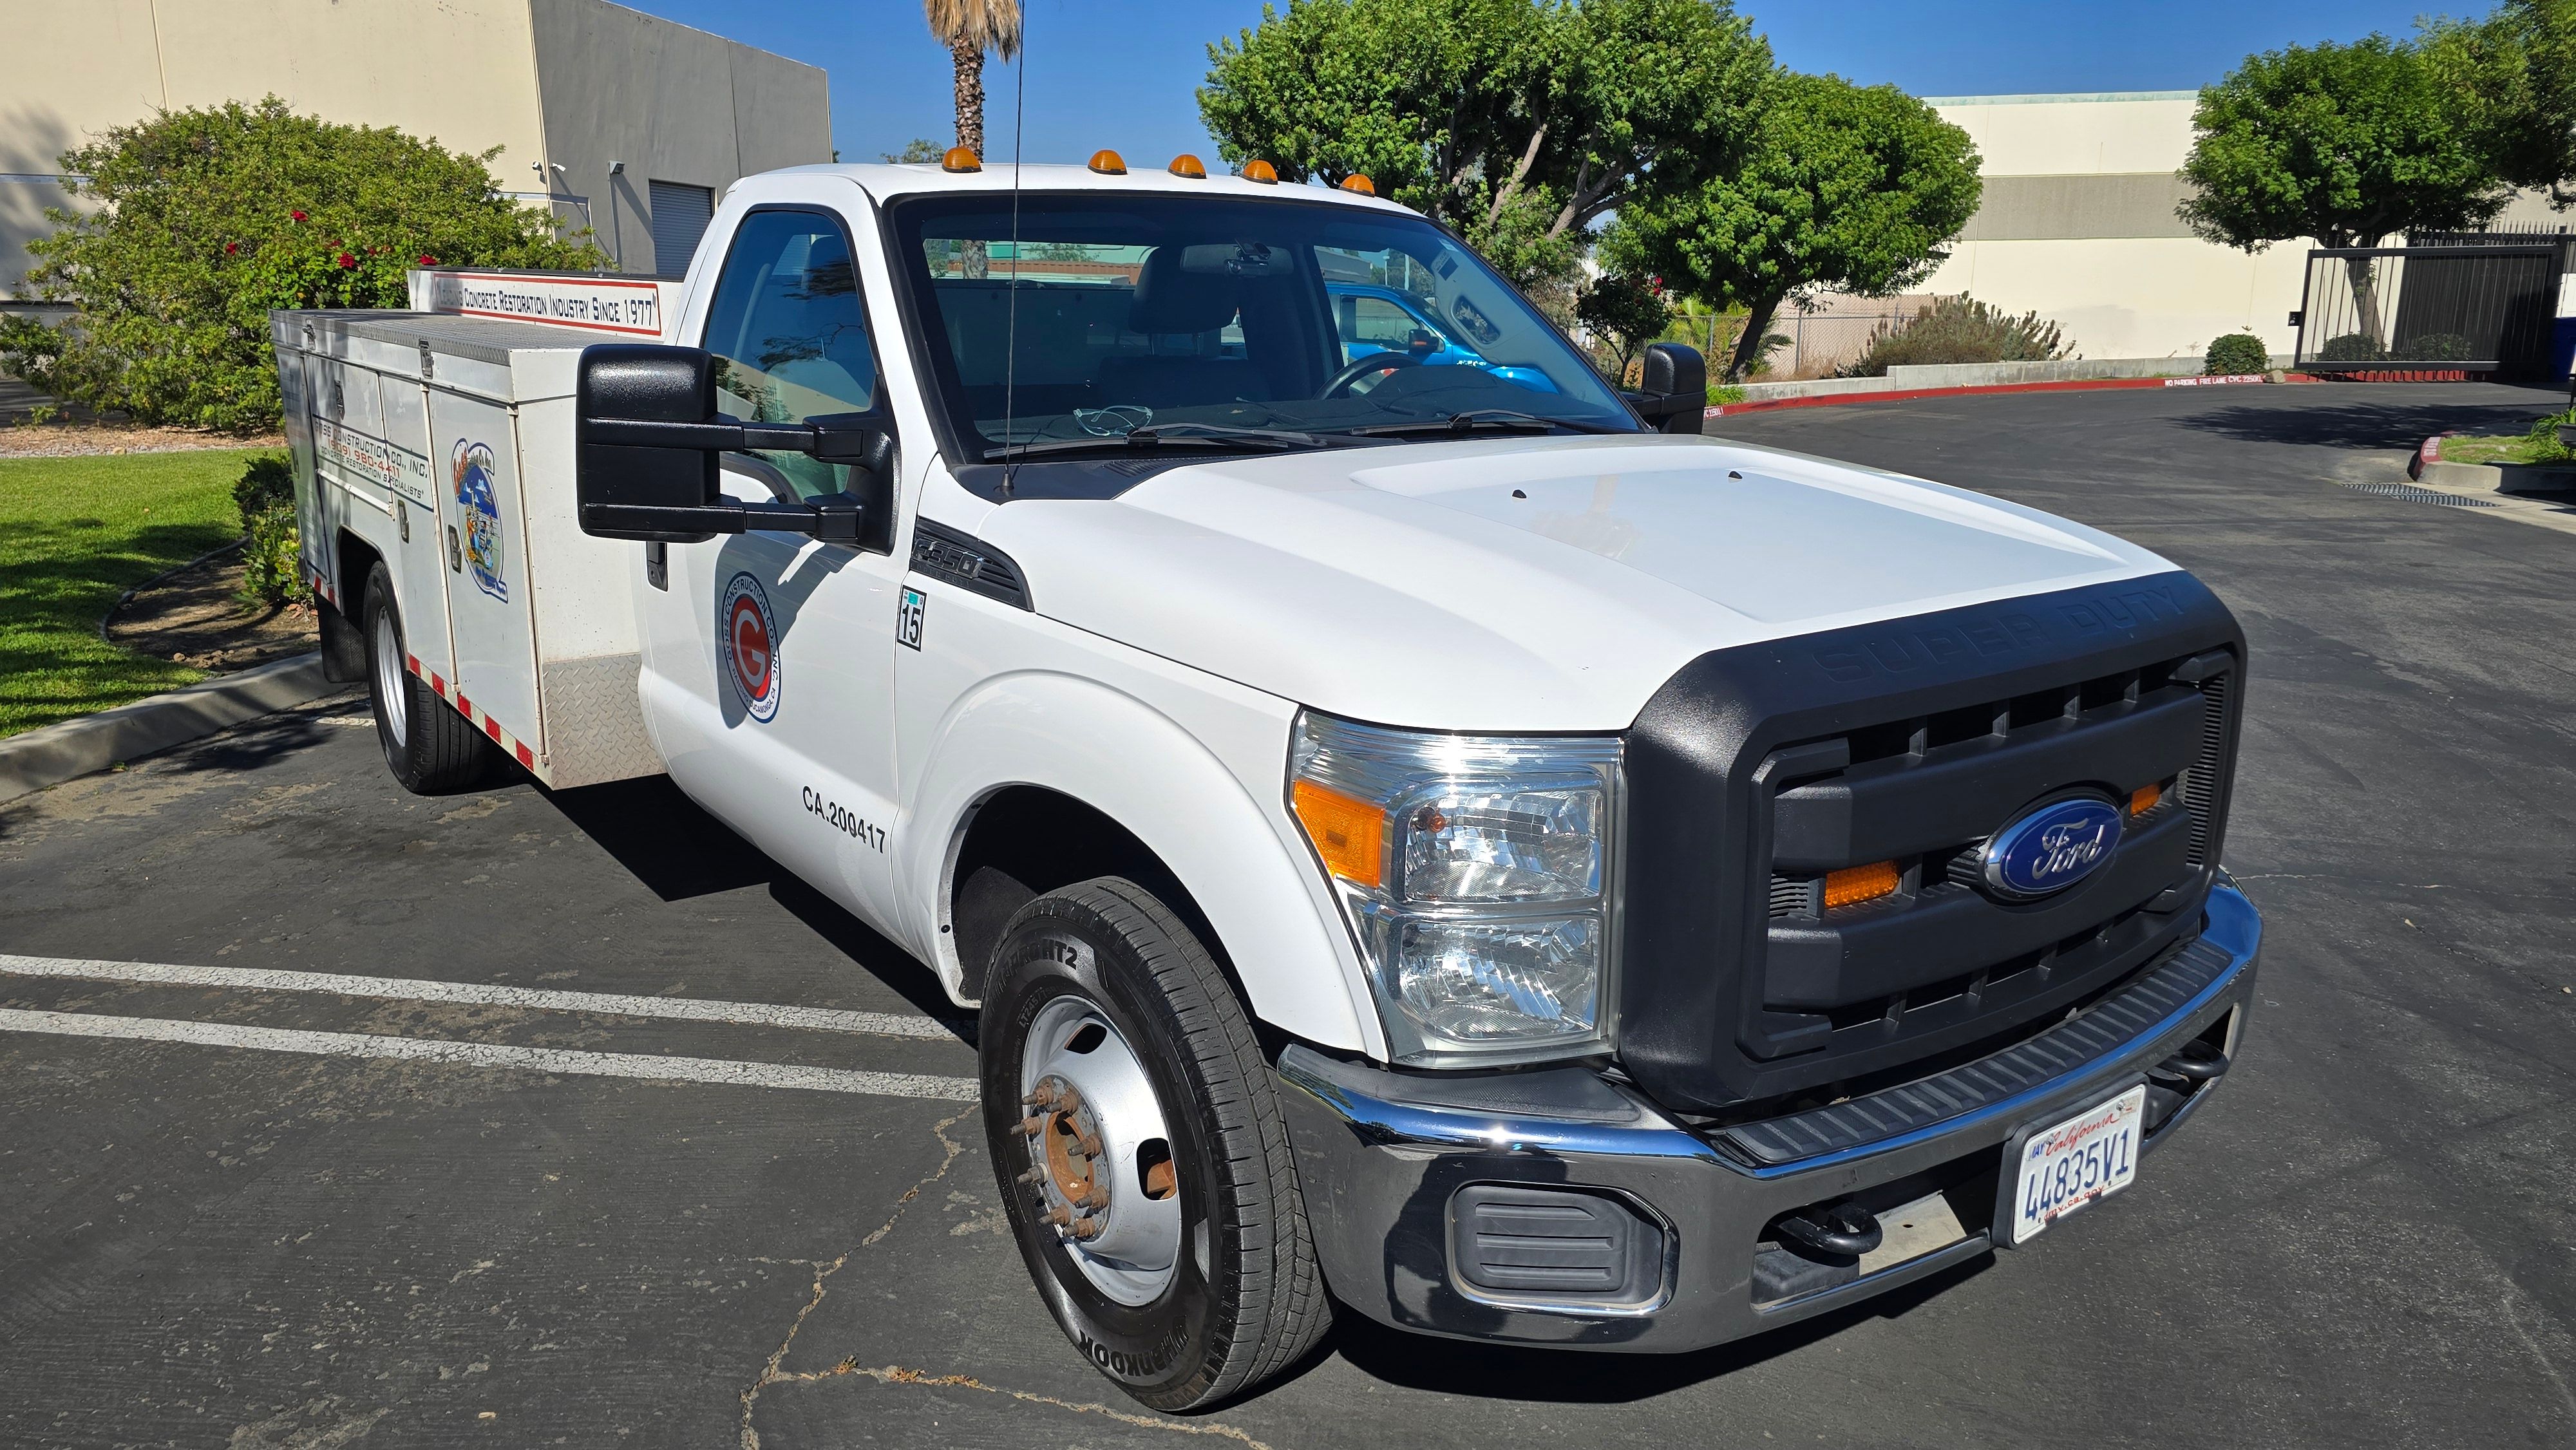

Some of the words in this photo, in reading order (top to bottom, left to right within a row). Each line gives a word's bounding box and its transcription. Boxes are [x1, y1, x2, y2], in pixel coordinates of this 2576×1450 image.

[464, 288, 498, 310] CONCRETE
[498, 290, 547, 315] RESTORATION
[549, 294, 589, 319] INDUSTRY
[592, 297, 620, 322] SINCE
[328, 438, 351, 457] (909)
[333, 428, 390, 460] CONSTRUCTION
[410, 458, 428, 478] INC.
[346, 457, 381, 480] RESTORATION
[725, 579, 768, 616] CONSTRUCTION
[724, 617, 732, 661] GOSS
[902, 603, 921, 644] 15
[1812, 613, 2054, 684] SUPER
[2056, 586, 2186, 634] DUTY
[735, 608, 765, 687] G
[732, 668, 749, 702] RANCHO
[770, 687, 776, 699] CA
[802, 786, 886, 854] CA.200417
[2032, 817, 2105, 880] Ford
[1042, 938, 1078, 971] HT2
[2046, 1111, 2121, 1156] California
[2024, 1127, 2129, 1221] 44835V1
